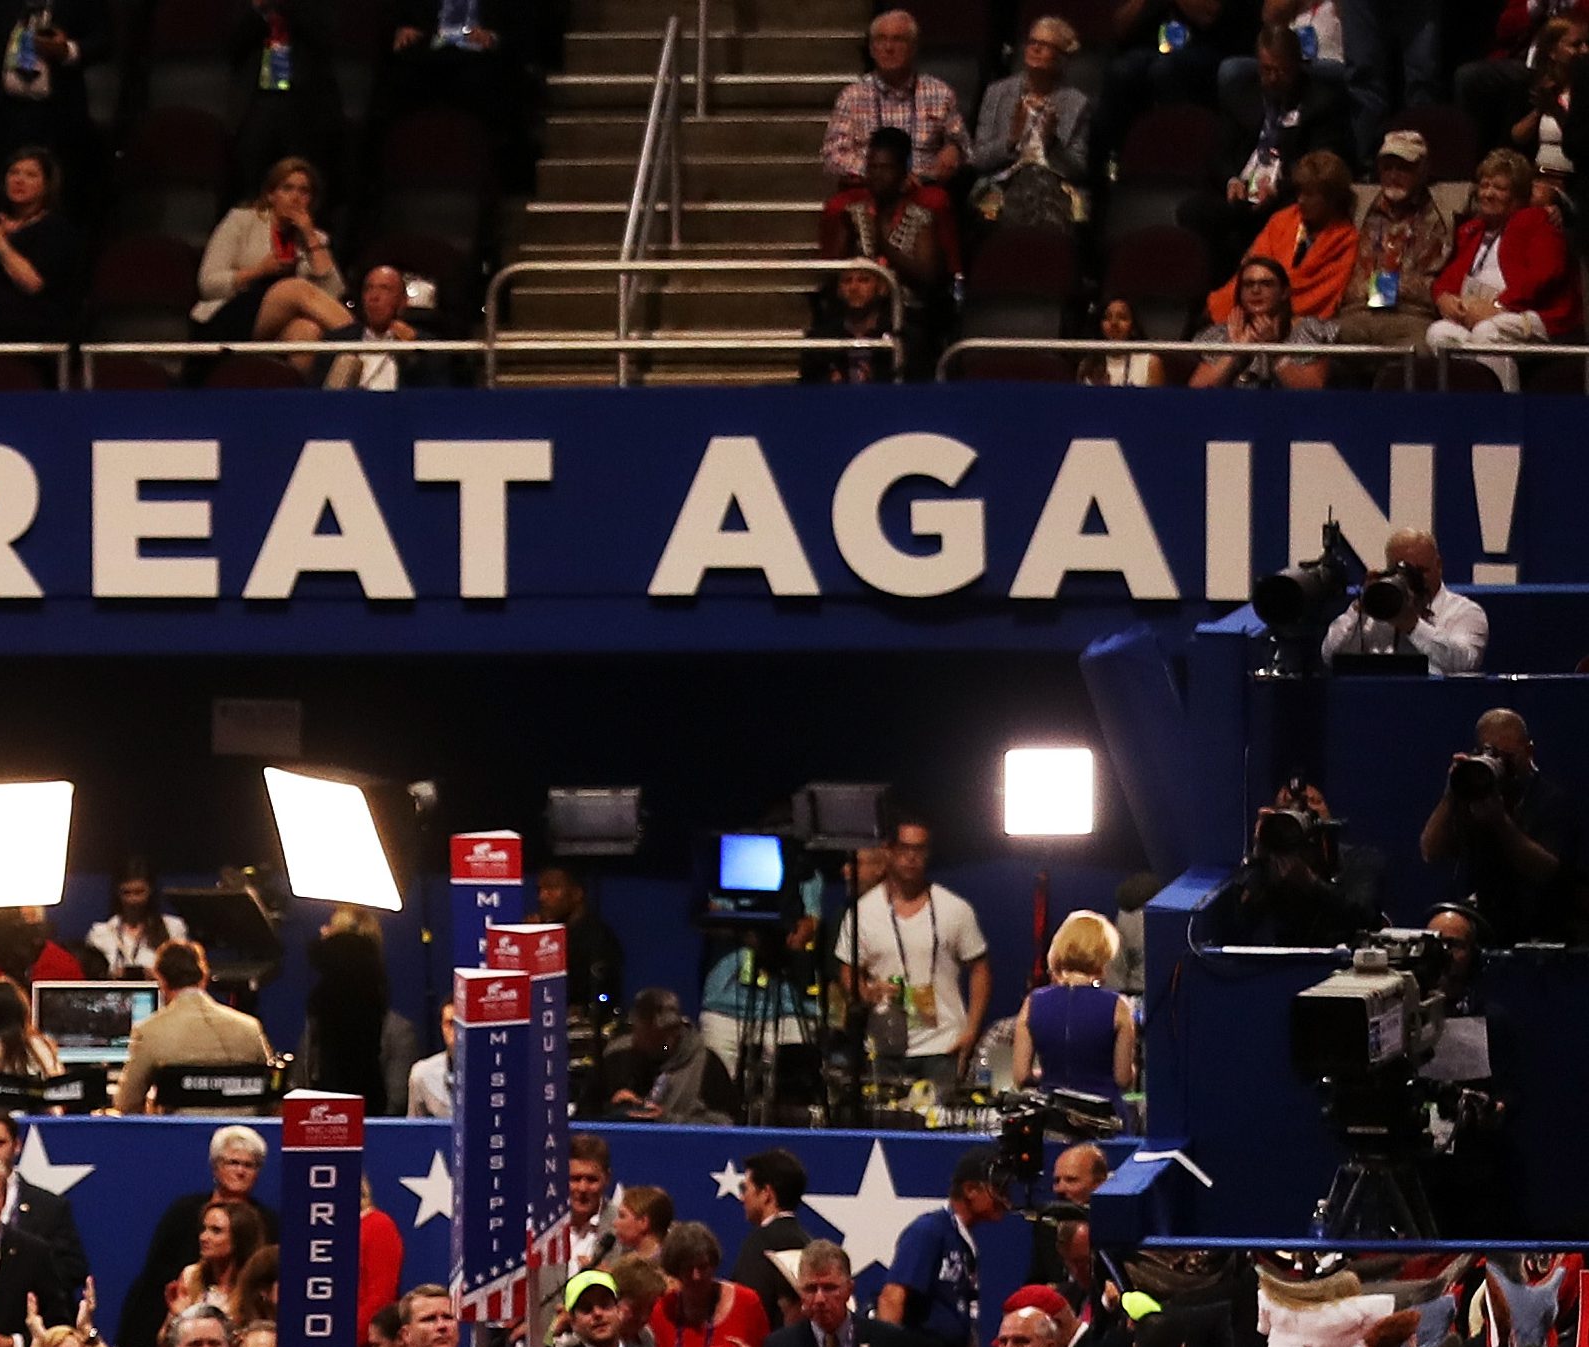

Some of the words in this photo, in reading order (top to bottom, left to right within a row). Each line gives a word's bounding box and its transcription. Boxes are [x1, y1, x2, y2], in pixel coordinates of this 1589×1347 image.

[647, 433, 1521, 603] AGAIN!
[489, 1031, 507, 1252] MISSISSIPPI
[542, 986, 558, 1199] LOUISIANA
